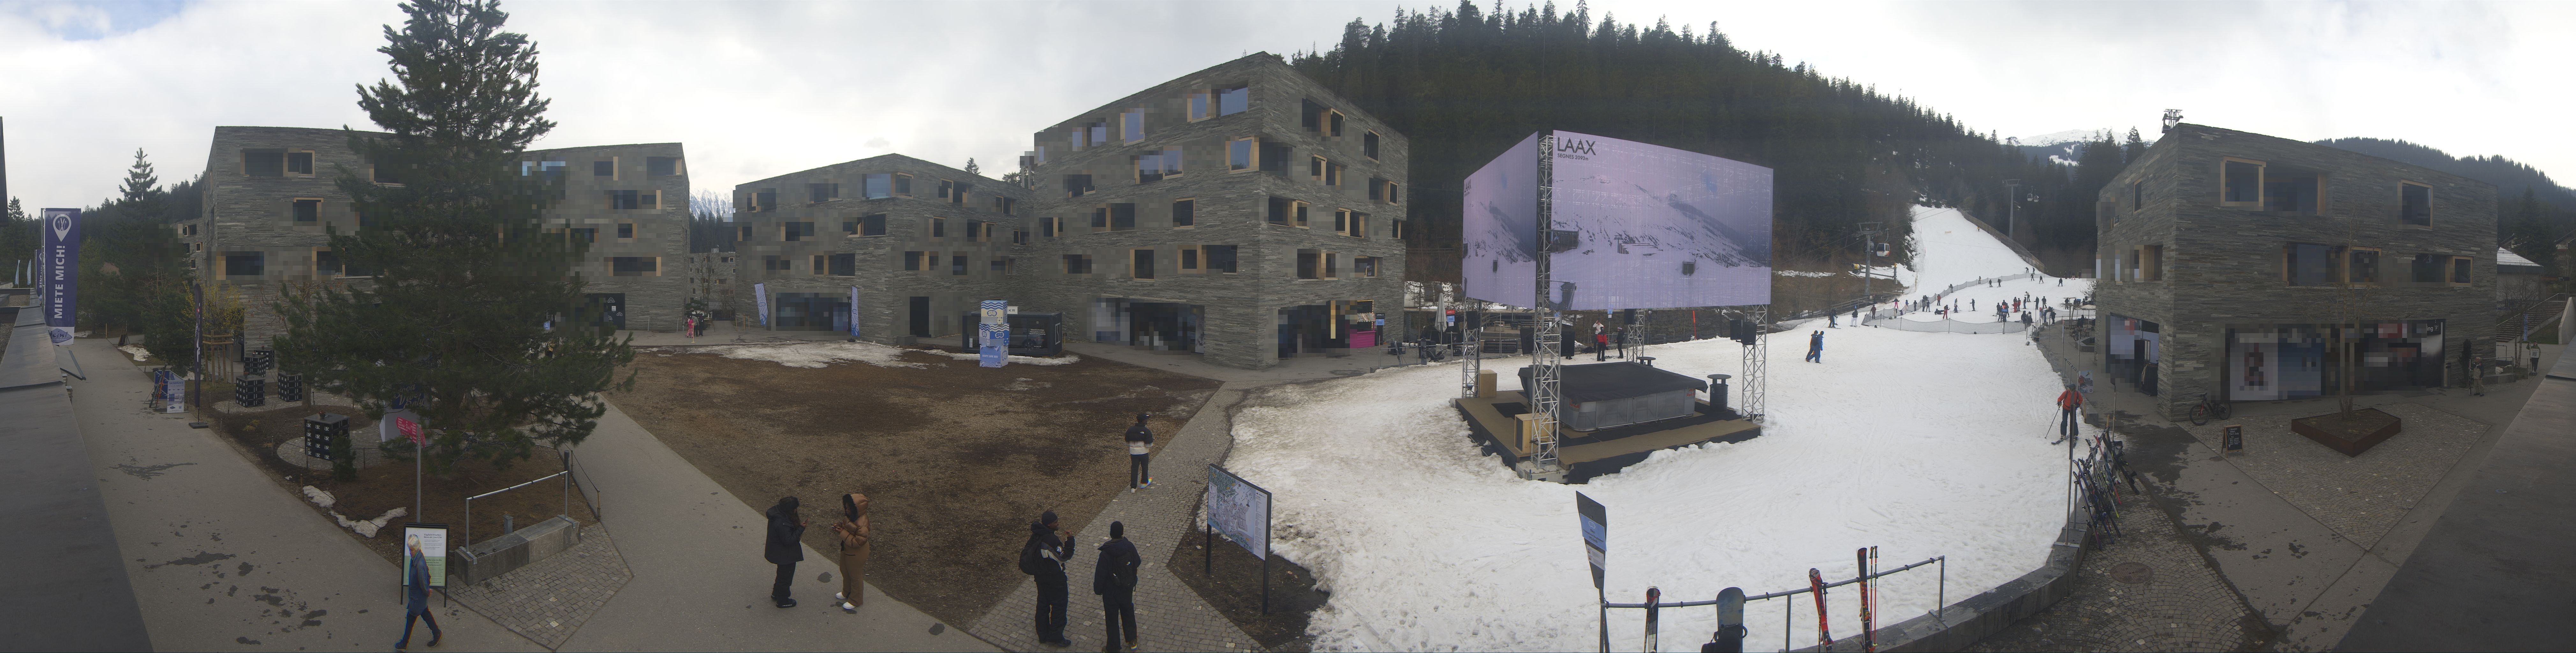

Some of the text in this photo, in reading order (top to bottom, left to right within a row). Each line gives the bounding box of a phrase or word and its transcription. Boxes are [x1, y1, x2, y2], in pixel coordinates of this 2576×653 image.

[1557, 137, 1596, 156] LAAX
[54, 245, 66, 319] MIETE MICH!
